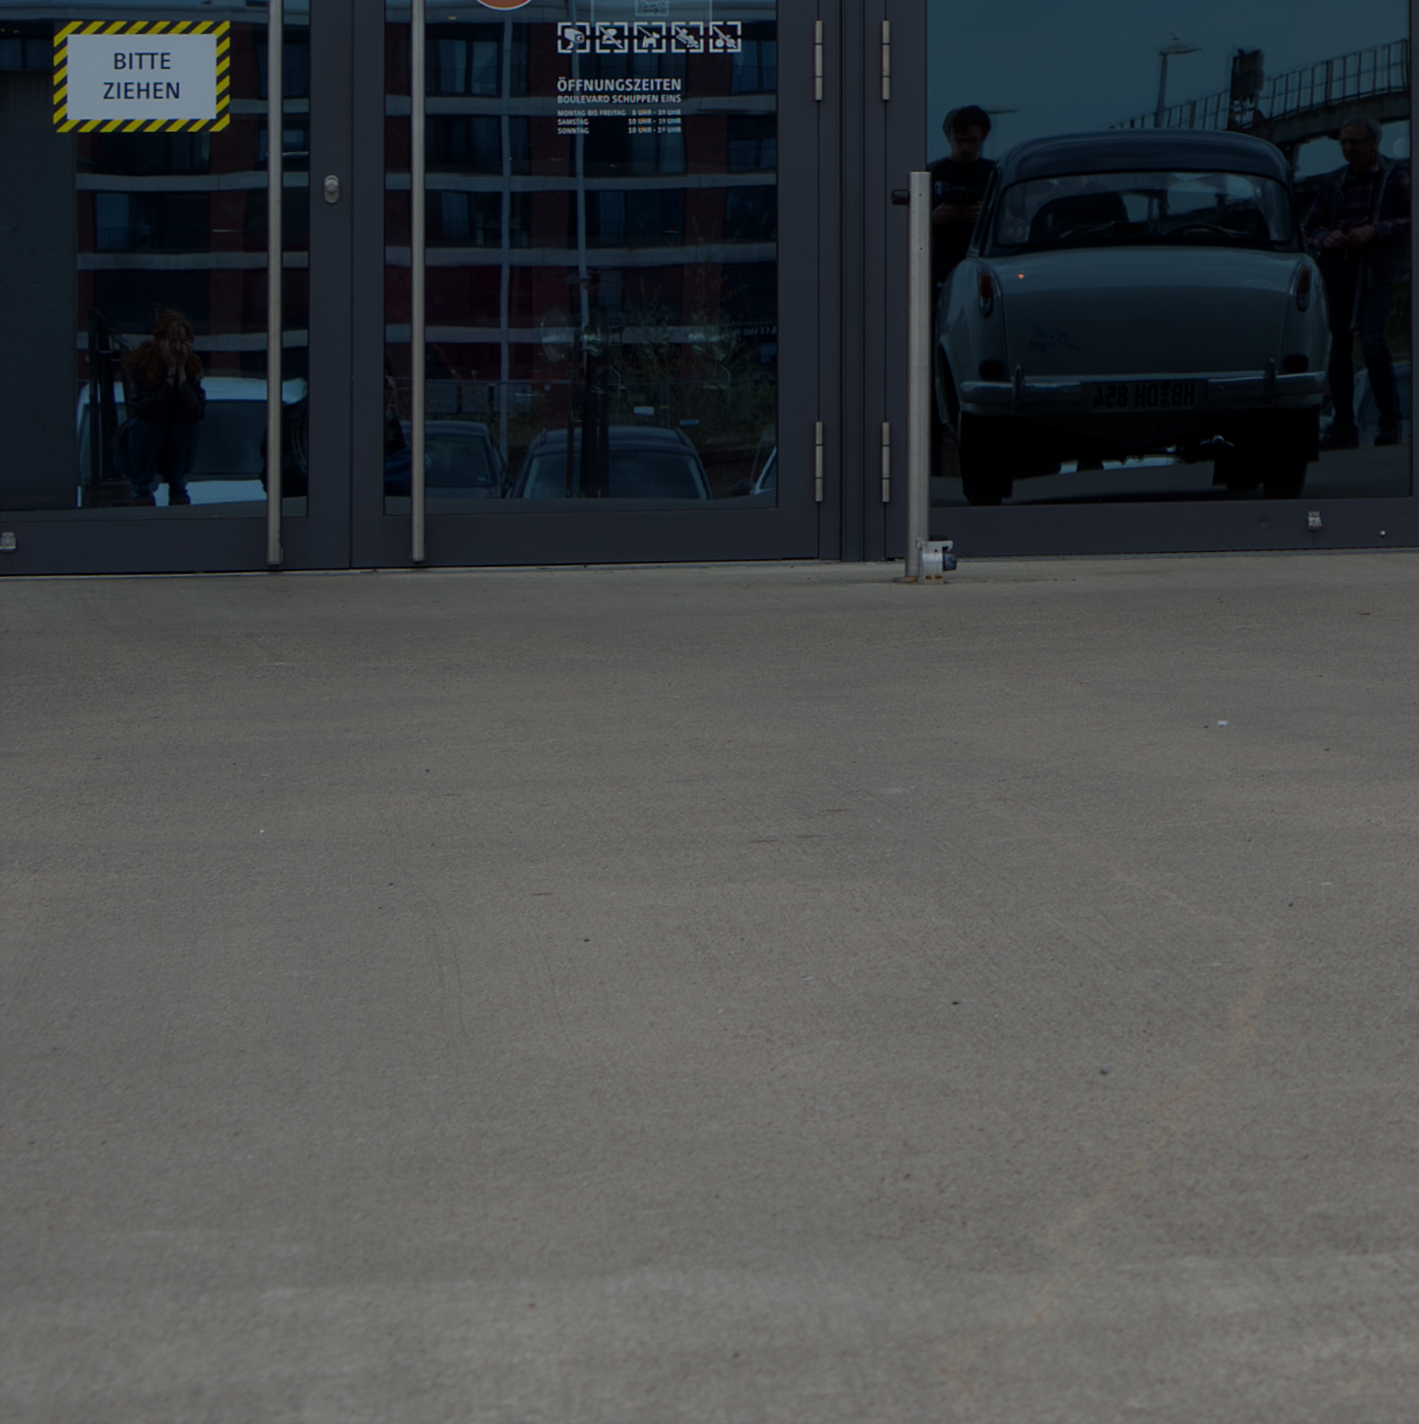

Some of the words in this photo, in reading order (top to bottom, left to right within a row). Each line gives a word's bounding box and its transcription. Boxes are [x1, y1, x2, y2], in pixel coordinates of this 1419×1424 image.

[114, 52, 171, 70] BITTE
[557, 76, 682, 92] ÖFFNUNGSZEITEN
[103, 82, 180, 100] ZIEHEN
[557, 95, 610, 104] BOULEVARD
[612, 94, 659, 103] SCHUPPEN
[661, 94, 682, 103] EINS
[557, 109, 587, 117] MONTAG
[587, 109, 598, 117] BIS
[557, 118, 589, 126] SAMSTAG
[557, 127, 590, 135] SONNTAG
[667, 126, 682, 134] UHR
